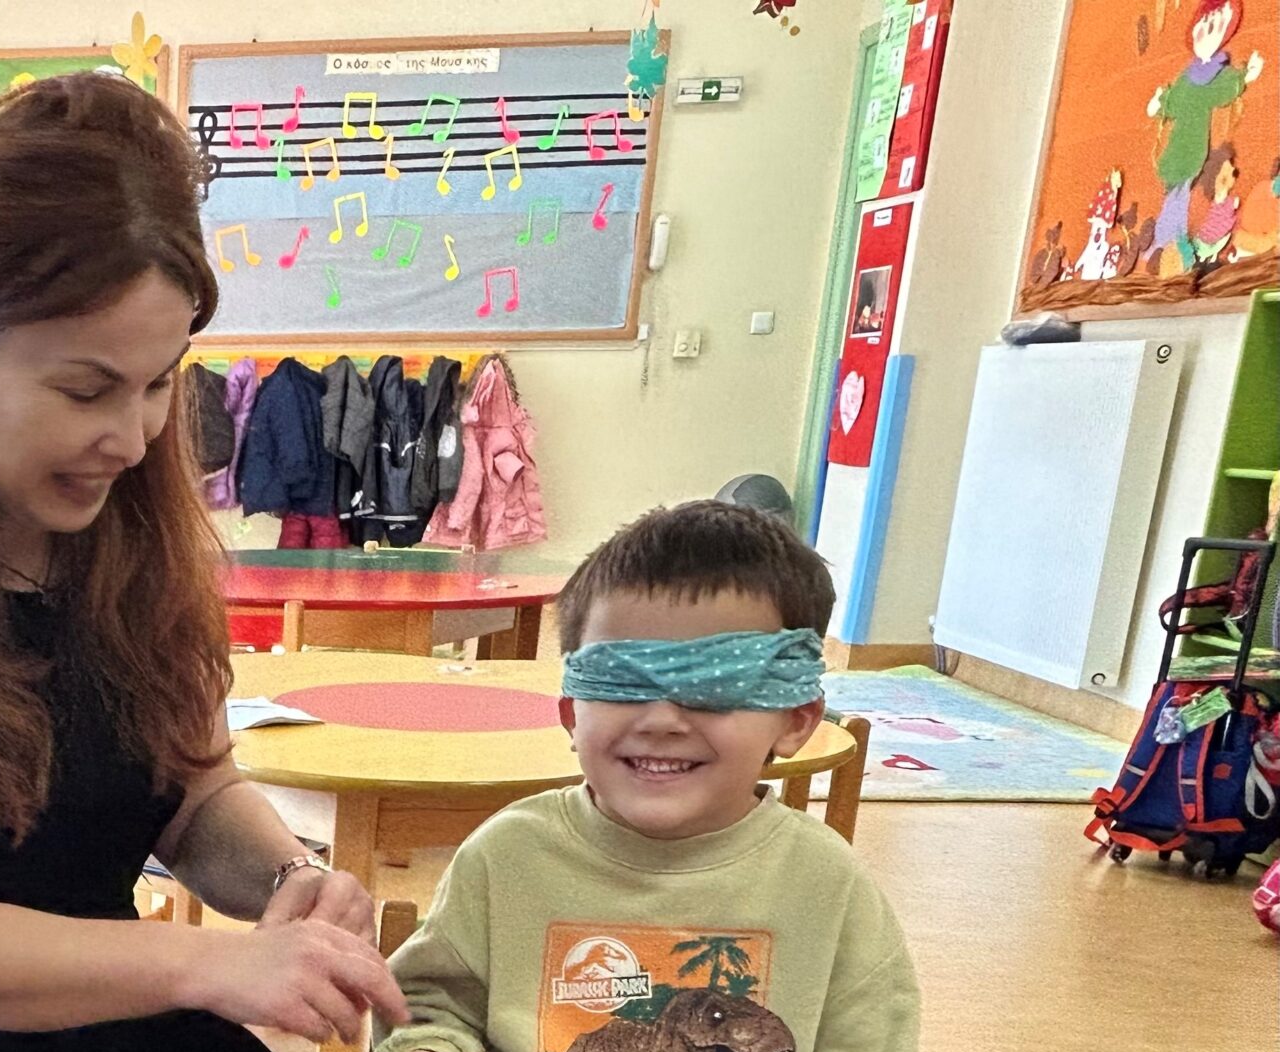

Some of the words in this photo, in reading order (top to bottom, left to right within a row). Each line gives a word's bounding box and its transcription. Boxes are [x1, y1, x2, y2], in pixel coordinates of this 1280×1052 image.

[333, 58, 342, 69] Ο
[346, 58, 391, 70] κόσος
[611, 977, 648, 998] PARK
